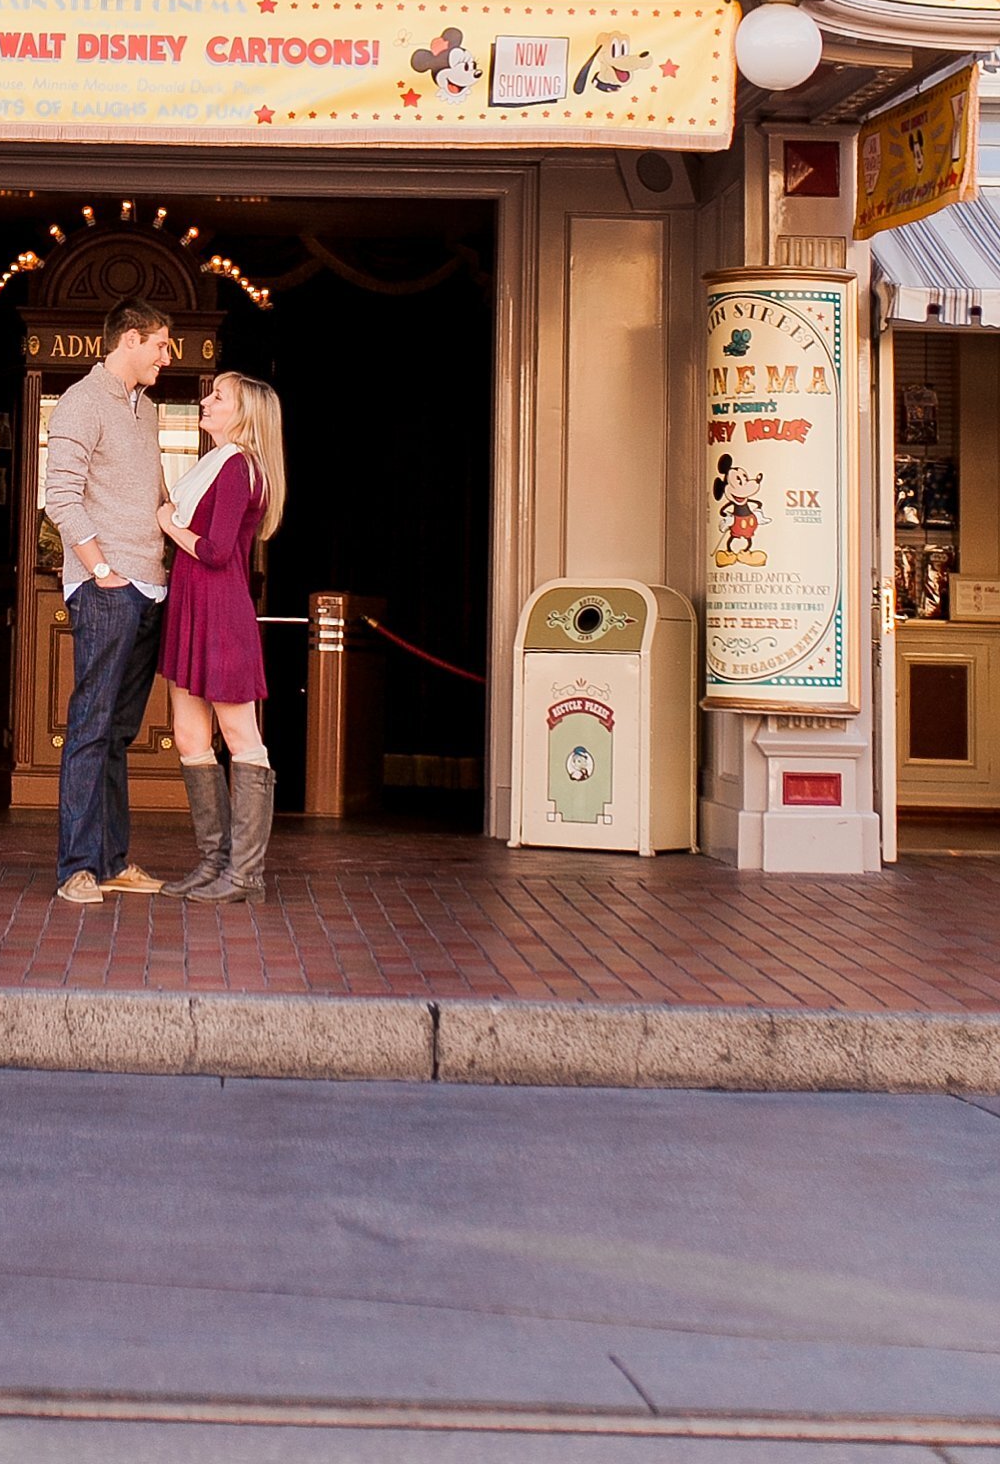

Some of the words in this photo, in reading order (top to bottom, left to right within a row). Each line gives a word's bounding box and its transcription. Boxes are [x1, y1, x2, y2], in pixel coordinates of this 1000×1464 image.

[77, 33, 188, 66] DISNEY
[206, 36, 381, 67] CARTOONS!
[515, 42, 547, 67] NOW
[32, 77, 80, 92] Minnie
[137, 76, 186, 94] Donald
[498, 72, 561, 98] SHOWING
[35, 99, 62, 117] OF
[71, 100, 147, 119] LAUGHS
[156, 103, 199, 120] AND
[733, 303, 820, 353] STREET
[744, 418, 813, 444] MOUSE
[786, 490, 820, 508] SIX
[728, 584, 753, 595] MOST
[755, 584, 793, 595] FAMOUS
[724, 618, 738, 629] IT
[741, 618, 798, 630] HERE!
